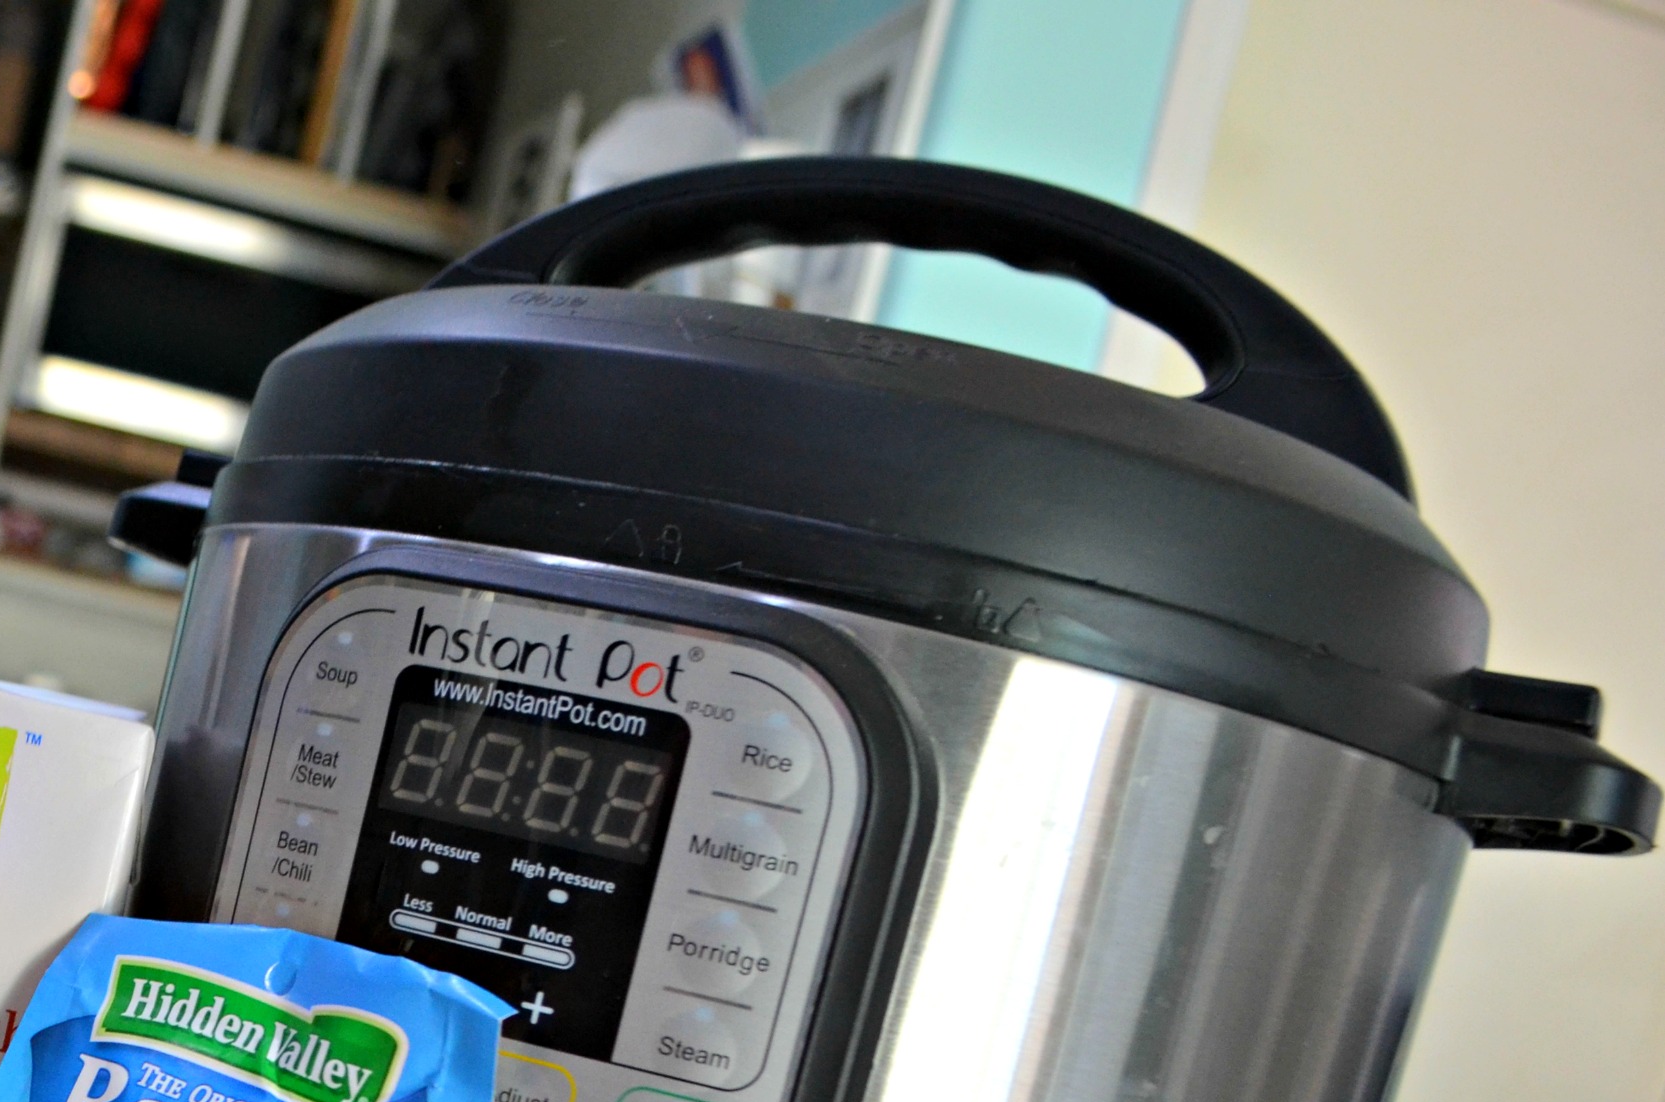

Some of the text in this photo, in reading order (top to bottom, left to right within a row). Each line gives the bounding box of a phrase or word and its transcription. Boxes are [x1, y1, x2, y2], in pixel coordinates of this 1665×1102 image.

[409, 607, 574, 682] Instant
[316, 661, 358, 688] Soup
[434, 678, 646, 737] www.InstantPot.com
[298, 744, 339, 769] Meat
[741, 745, 793, 773] Rice
[290, 763, 337, 789] /Stew
[277, 831, 318, 856] Bean
[389, 830, 481, 863] Low Pressure
[688, 834, 799, 876] Multigrain
[271, 857, 313, 882] /Chili
[510, 858, 616, 894] High Pressure
[403, 893, 573, 948] Less Normal More
[666, 933, 771, 976] Porridge
[121, 978, 264, 1053] Hidden
[657, 1036, 731, 1070] Steam
[136, 1062, 186, 1100] THE
